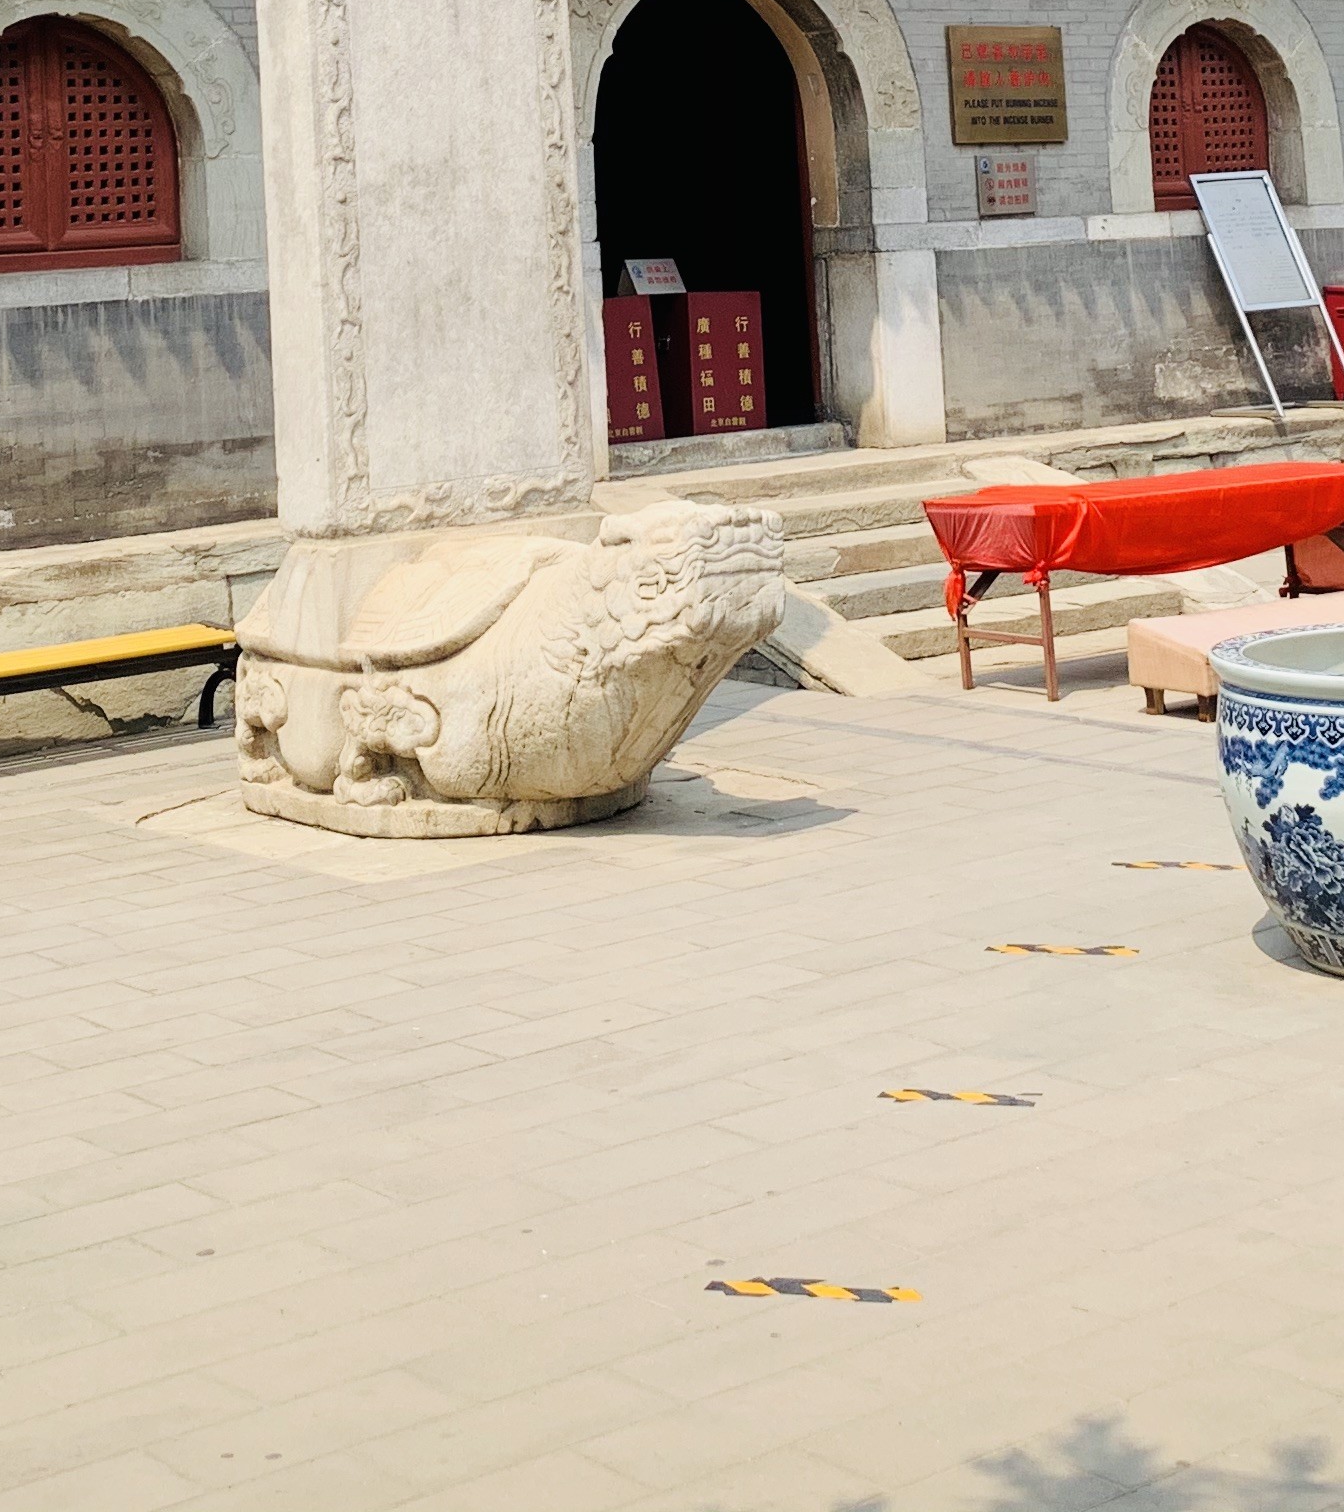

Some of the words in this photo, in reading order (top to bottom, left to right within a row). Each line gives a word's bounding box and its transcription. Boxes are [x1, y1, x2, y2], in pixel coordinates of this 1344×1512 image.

[964, 98, 989, 108] PLEASE
[991, 98, 1003, 108] PUT
[1006, 98, 1031, 108] BURNING
[1033, 98, 1058, 108] INCENSE
[971, 116, 987, 125] INTO
[989, 115, 1001, 125] THE
[1003, 115, 1028, 125] INCENSE
[1030, 115, 1054, 124] BURNER
